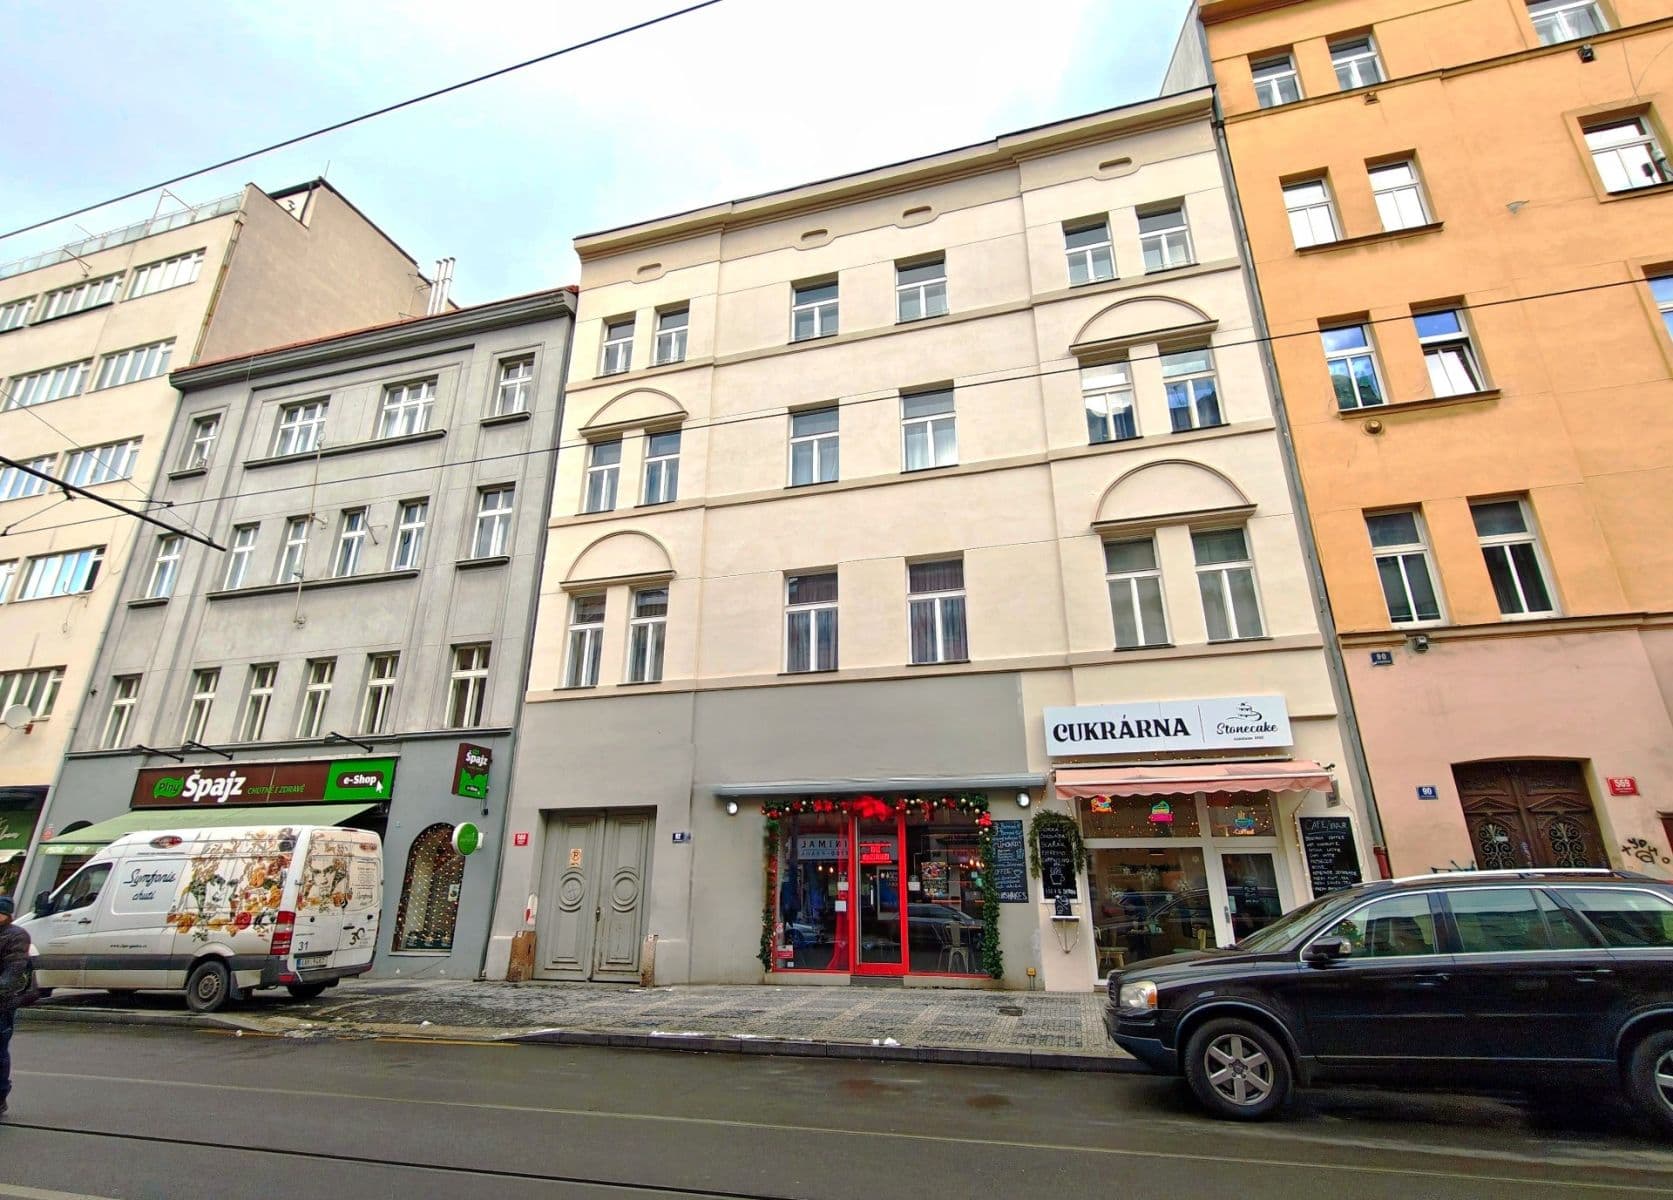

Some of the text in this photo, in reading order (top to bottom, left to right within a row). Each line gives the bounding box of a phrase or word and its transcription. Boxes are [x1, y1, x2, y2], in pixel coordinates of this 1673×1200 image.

[1053, 714, 1191, 743] CUKRÁRNA
[1216, 721, 1278, 735] Stonecake
[465, 749, 488, 767] Špajz
[182, 769, 247, 803] Špajz
[343, 774, 377, 786] e-Shop
[1421, 787, 1433, 795] 90
[123, 868, 177, 887] Symfonie
[298, 940, 309, 952] 31
